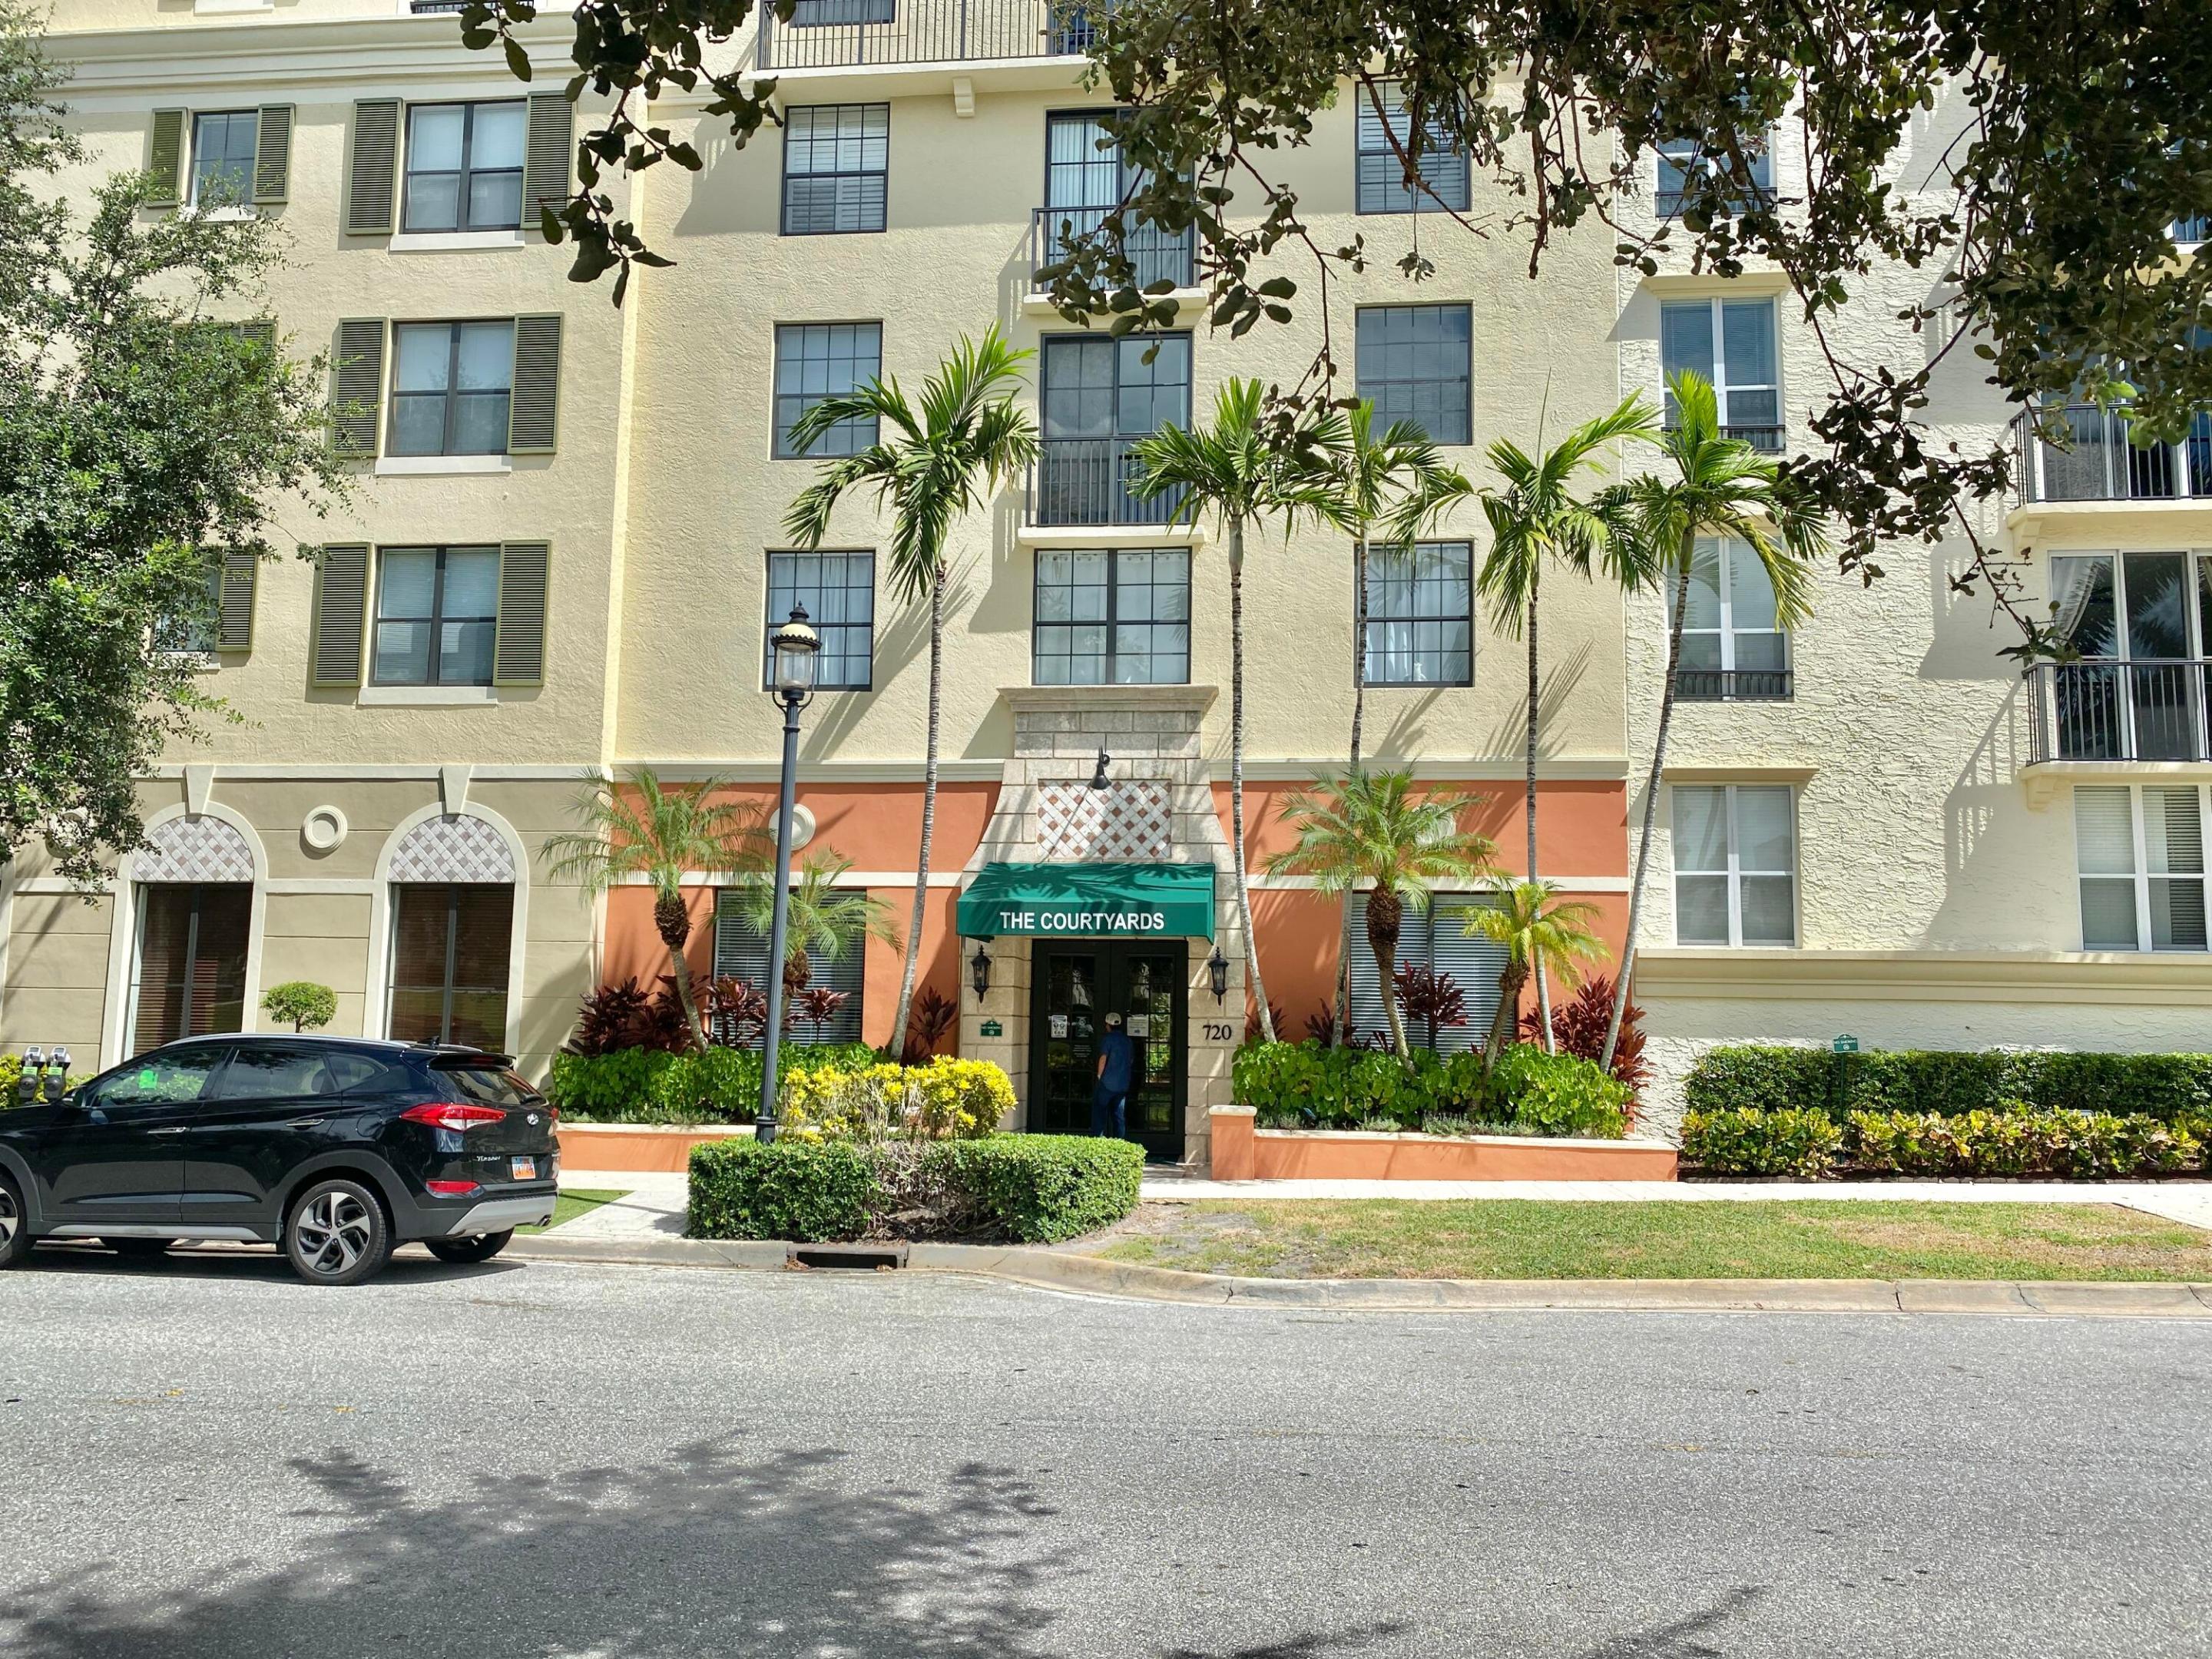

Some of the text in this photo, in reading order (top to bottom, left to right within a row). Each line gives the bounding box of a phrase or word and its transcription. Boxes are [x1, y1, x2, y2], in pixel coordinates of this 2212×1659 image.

[1000, 912, 1164, 930] THE COURTYARDS
[1202, 1025, 1232, 1040] 720
